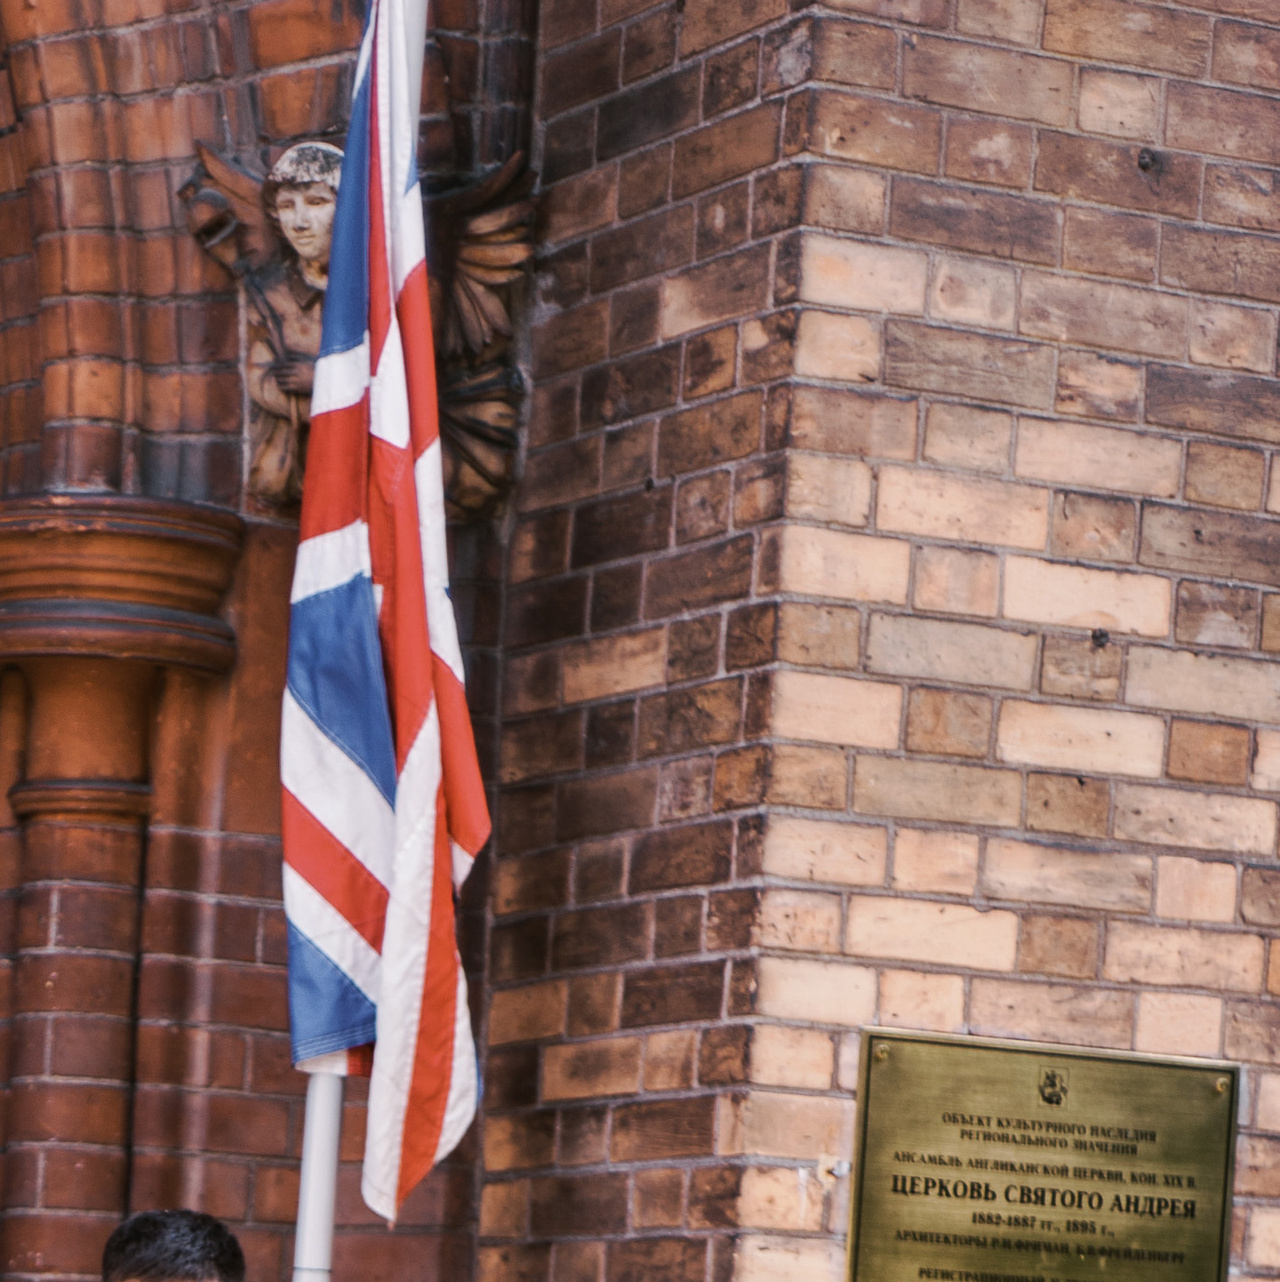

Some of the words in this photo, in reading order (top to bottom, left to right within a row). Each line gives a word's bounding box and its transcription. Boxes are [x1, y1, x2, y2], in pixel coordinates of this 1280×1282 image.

[942, 1111, 992, 1127] ОБЪЕКТ
[996, 1117, 1086, 1136] КУЛЬТУРНОГО
[1090, 1125, 1157, 1143] НАСЛЕДИЯ
[960, 1128, 1068, 1148] РЕГИОНАЛЬНОГО
[1073, 1138, 1138, 1155] ЗНАЧЕНИЯ
[893, 1150, 962, 1167] АНСАМБЛЬ
[967, 1157, 1069, 1178] АНГЛИКАНСКОЙ
[1073, 1166, 1126, 1184] ЦЕРКВИ,
[891, 1174, 997, 1201] ЦЕРКОВЬ
[1004, 1183, 1103, 1210] СВЯТОГО
[1110, 1194, 1197, 1219] АНДРЕЯ
[895, 1229, 988, 1247] АРХИТЕКТОРЫ
[1066, 1220, 1096, 1235] 1895
